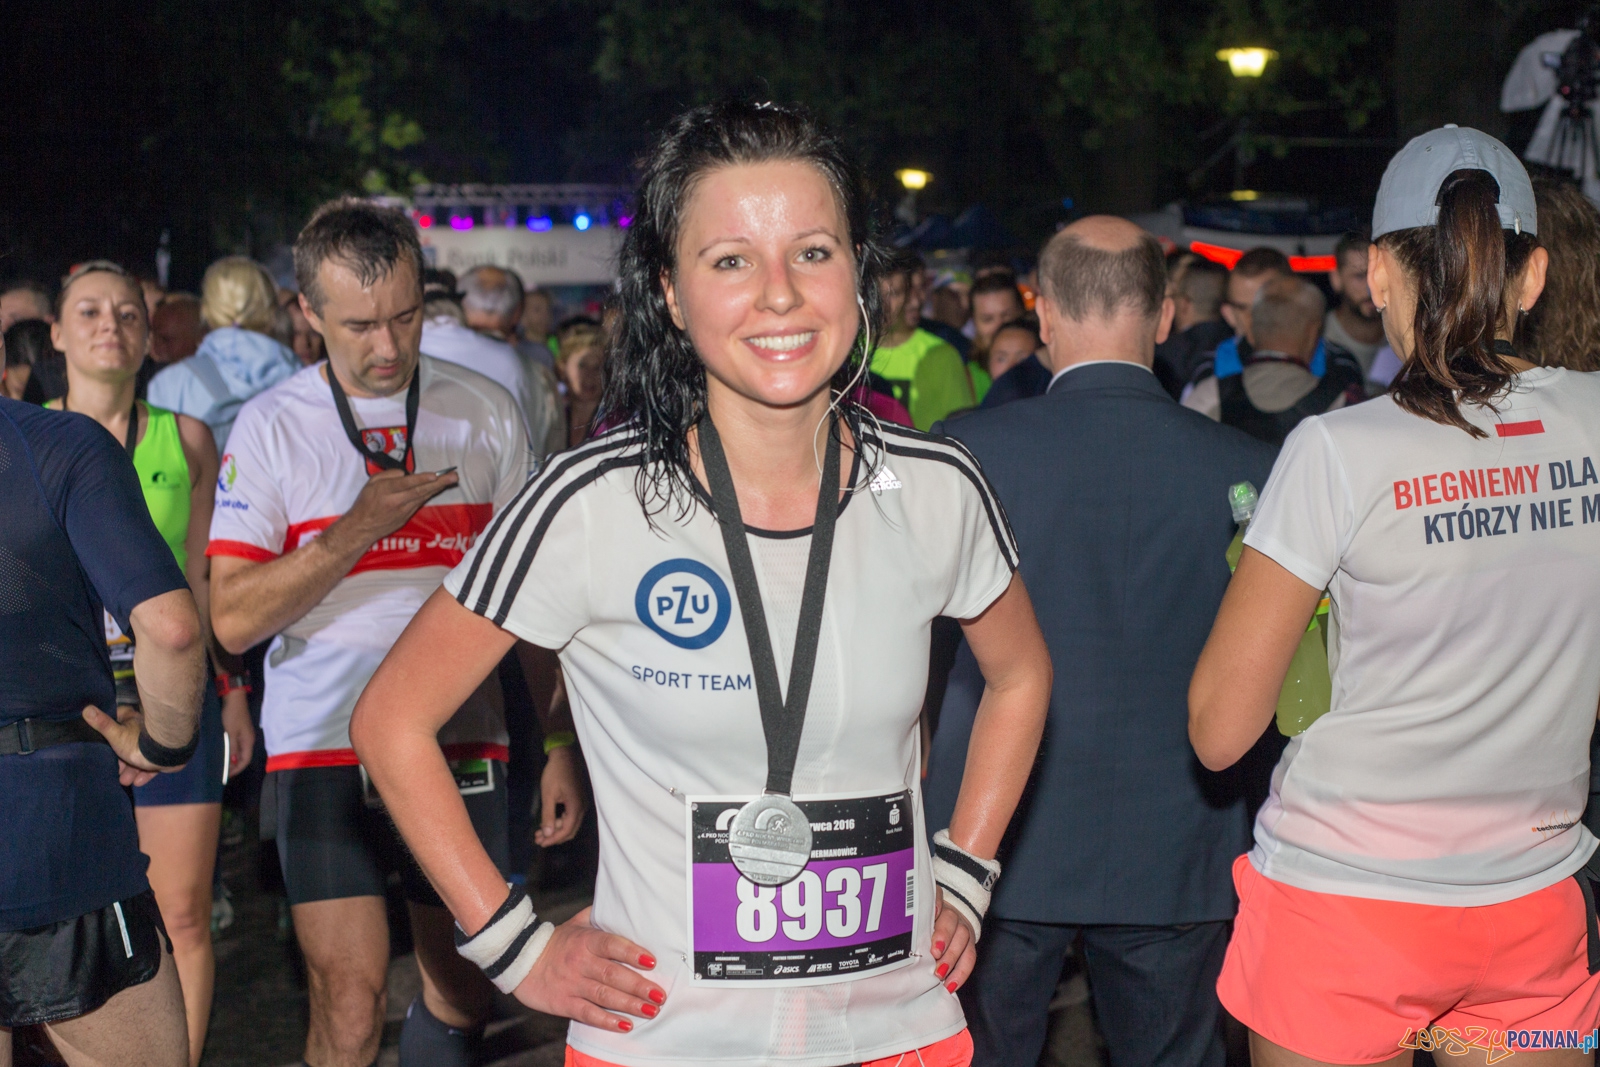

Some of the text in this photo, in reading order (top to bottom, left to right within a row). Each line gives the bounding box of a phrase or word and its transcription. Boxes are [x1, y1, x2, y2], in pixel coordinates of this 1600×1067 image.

[1393, 456, 1599, 510] BIEGNIEMY DLA
[1424, 502, 1521, 545] KTÓRZY
[1530, 498, 1574, 531] NIE
[656, 585, 710, 625] PZU
[632, 665, 752, 691] SPORT TEAM
[833, 819, 855, 831] 2016
[735, 862, 888, 943] 8937
[782, 965, 800, 974] asics
[838, 959, 860, 967] TOYOTA
